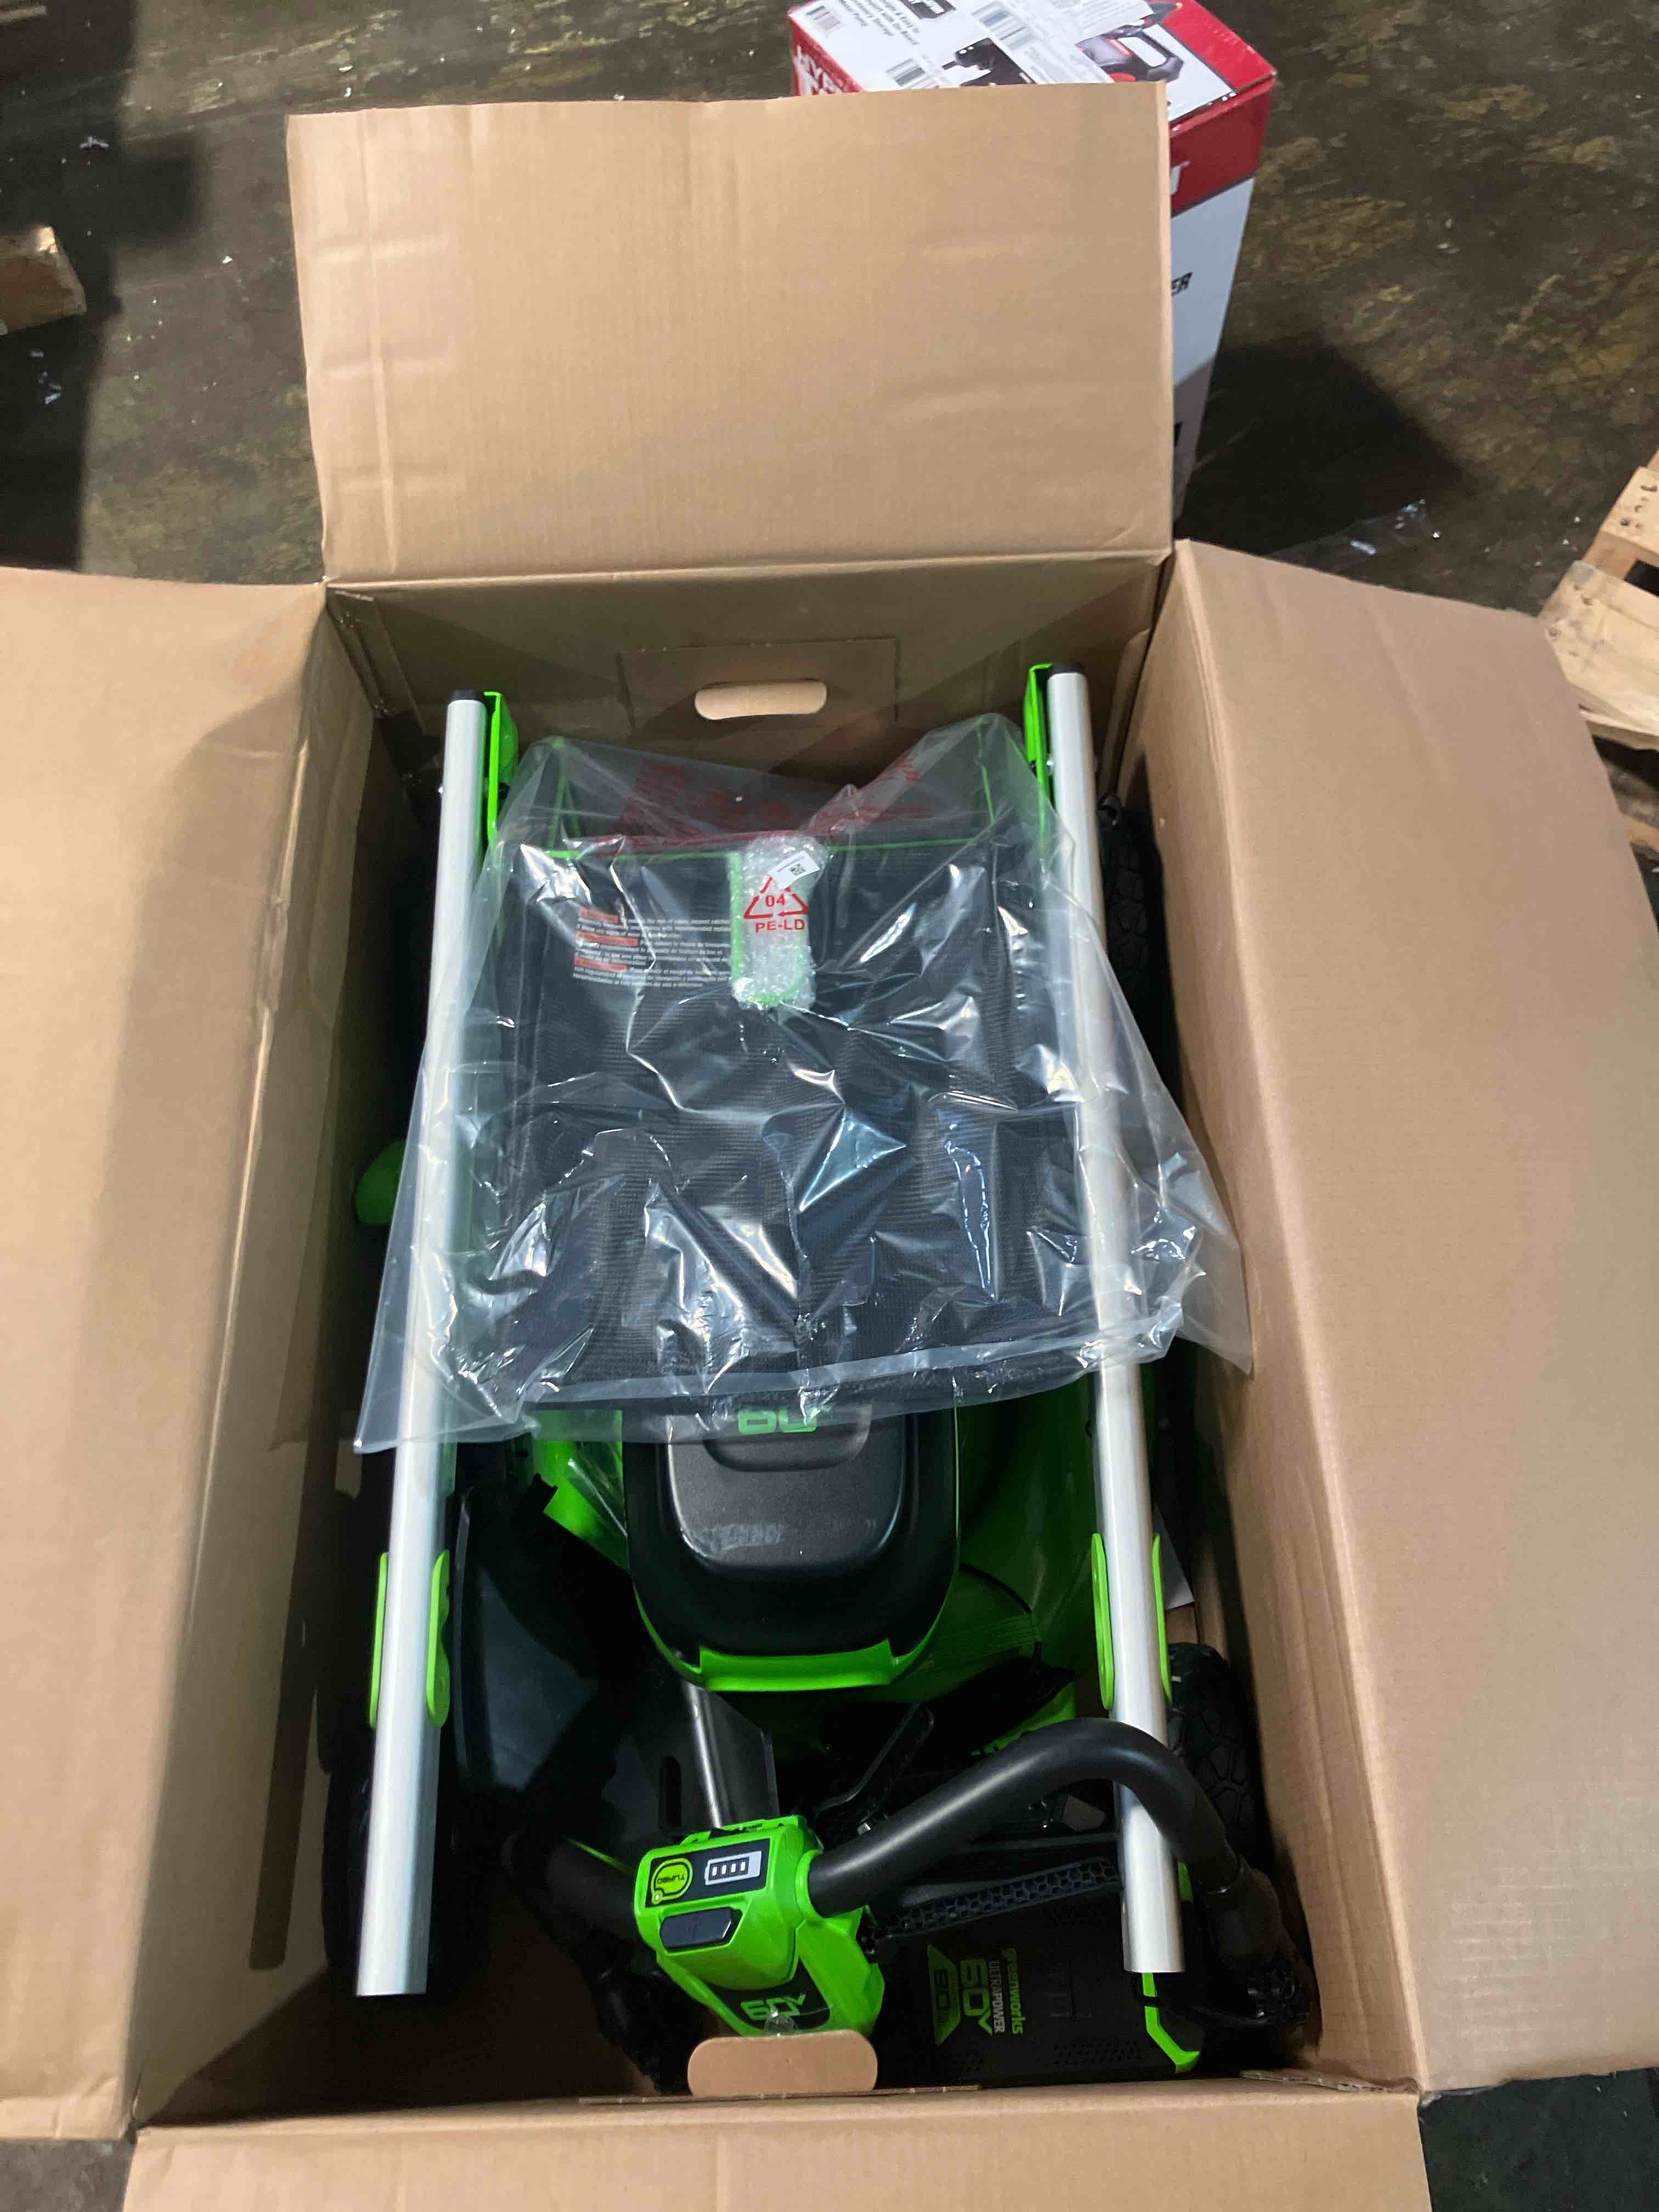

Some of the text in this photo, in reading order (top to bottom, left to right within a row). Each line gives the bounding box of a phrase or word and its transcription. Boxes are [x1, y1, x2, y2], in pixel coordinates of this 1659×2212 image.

[765, 893, 786, 907] 04
[755, 918, 805, 933] PE-LD
[657, 1874, 686, 1884] TURBO
[960, 1957, 993, 2036] 60V
[989, 1961, 1005, 2033] ULTRAPOWER
[1001, 1948, 1026, 2035] greenworks
